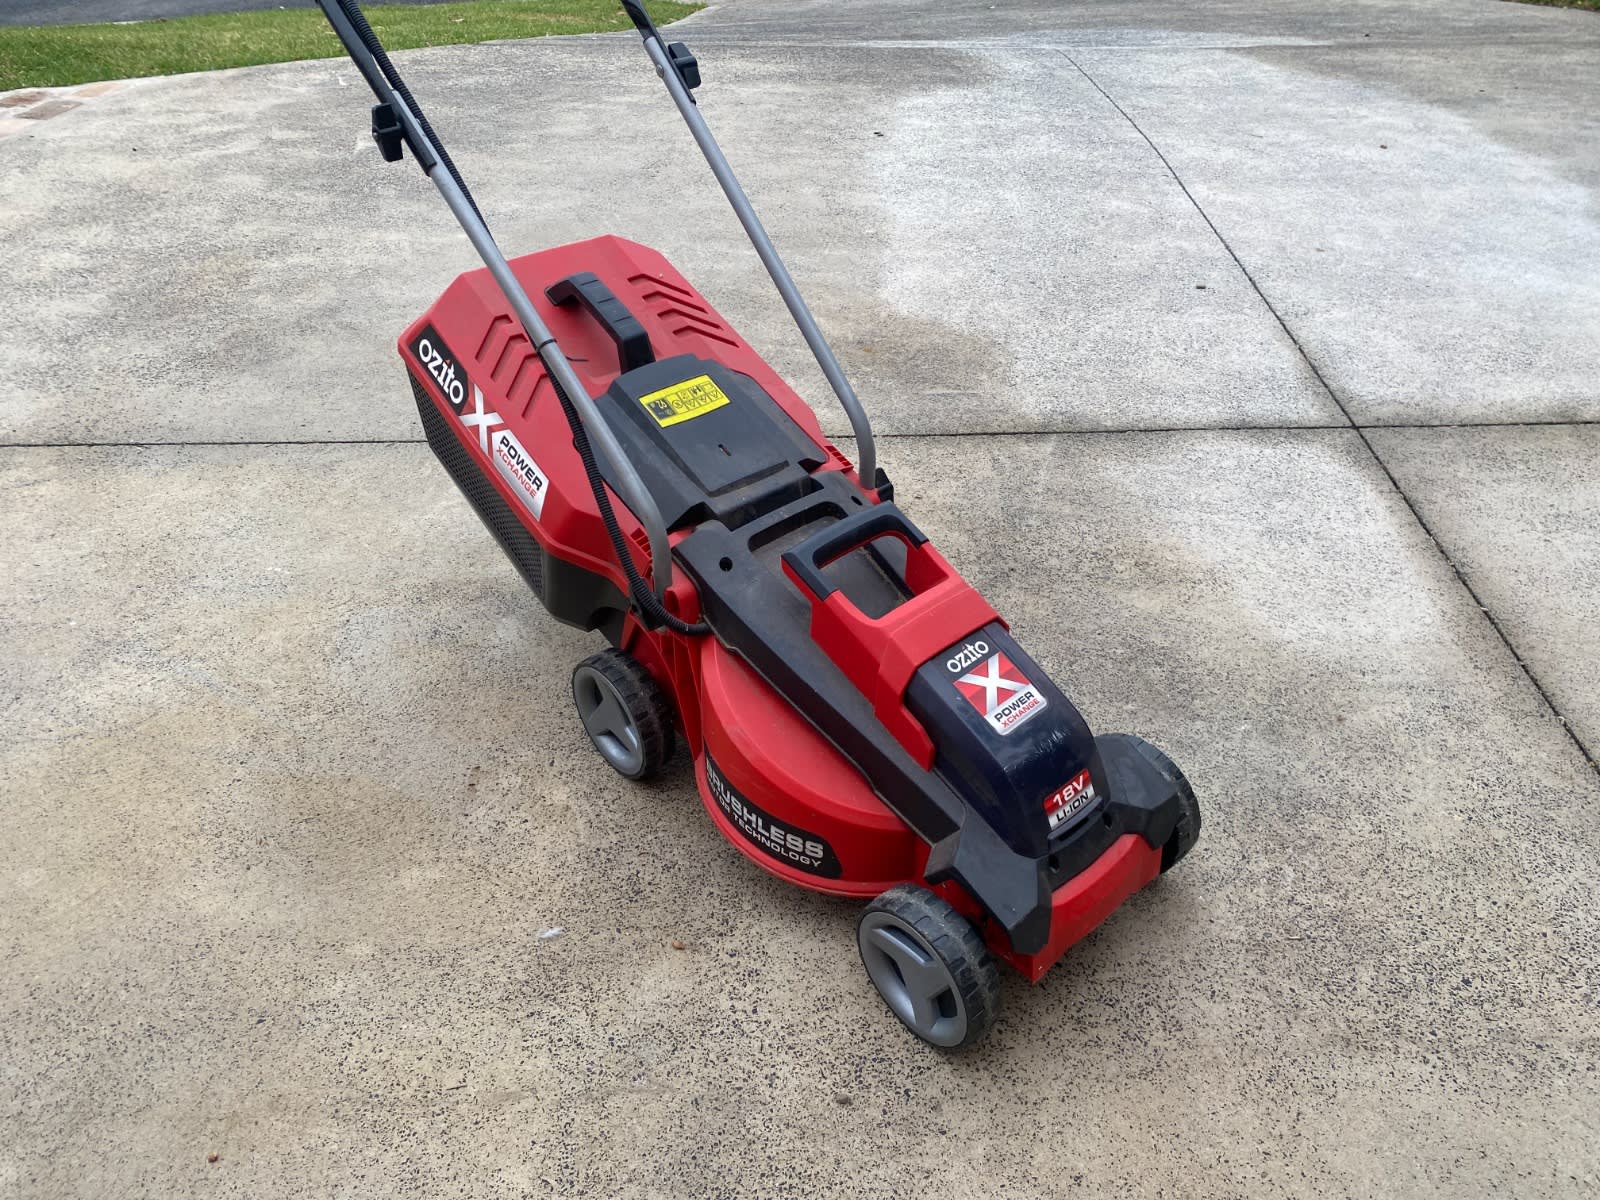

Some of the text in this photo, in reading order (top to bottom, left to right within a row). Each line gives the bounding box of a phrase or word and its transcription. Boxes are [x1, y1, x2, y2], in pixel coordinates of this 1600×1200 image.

[496, 447, 536, 498] XCHANGE
[500, 435, 543, 491] POWER
[994, 691, 1035, 722] POWER
[1000, 697, 1040, 728] XCHANGE
[1052, 774, 1085, 806] 18V
[732, 813, 822, 867] TECHNOLOGY
